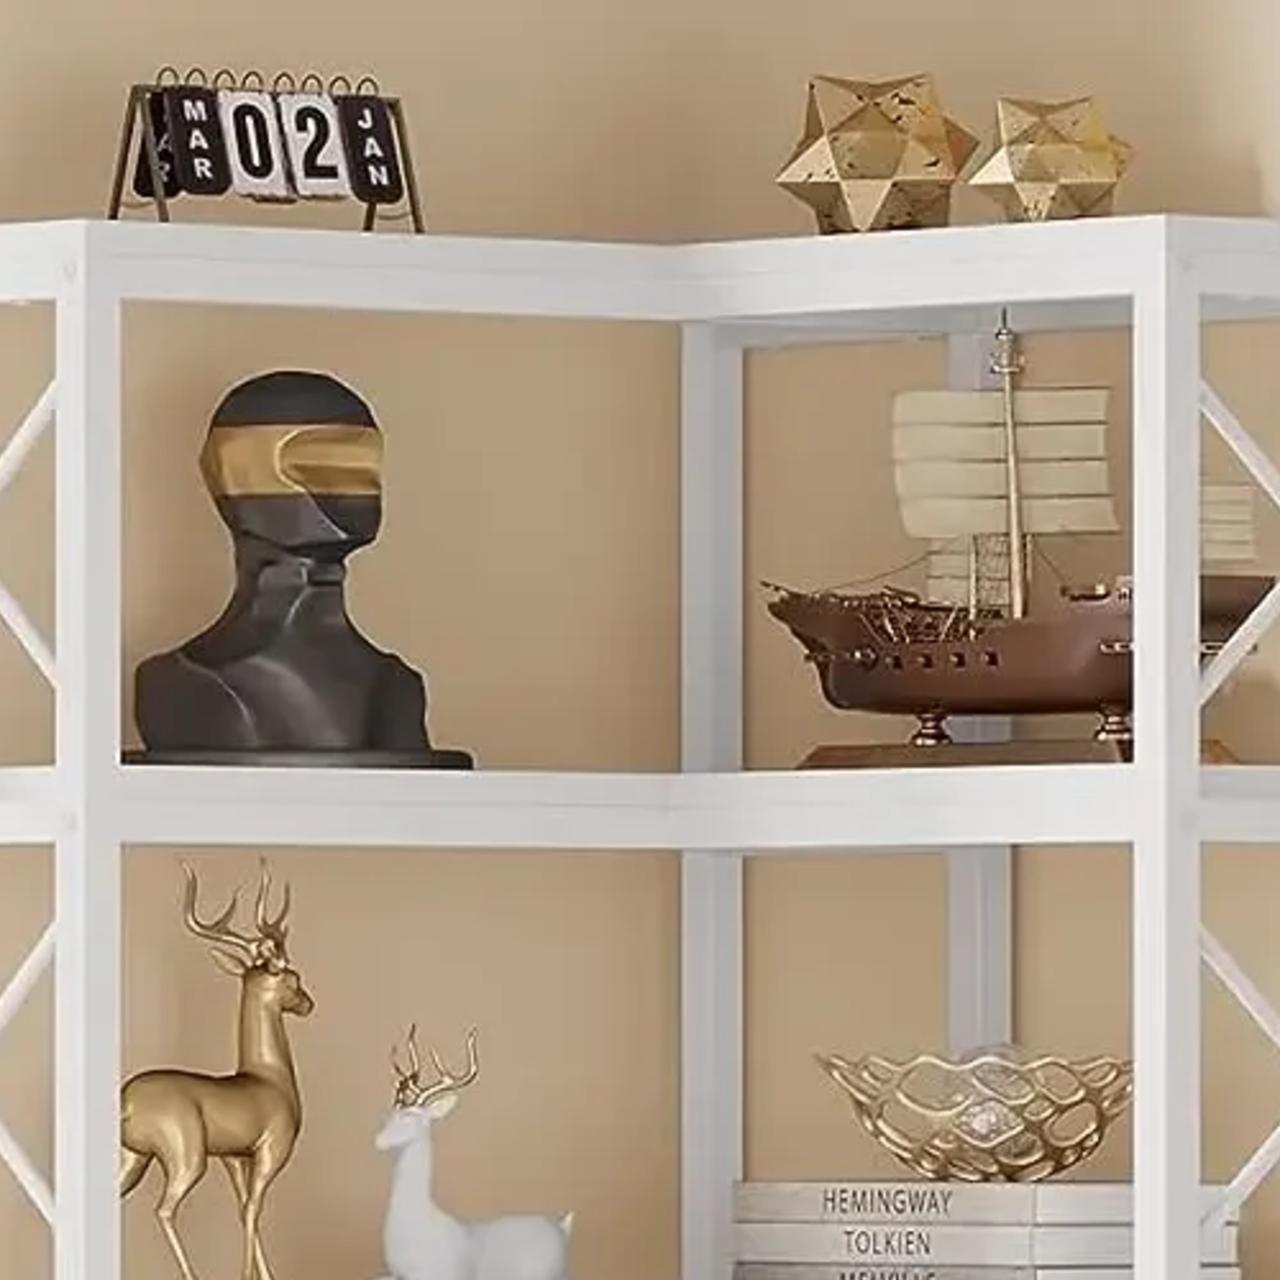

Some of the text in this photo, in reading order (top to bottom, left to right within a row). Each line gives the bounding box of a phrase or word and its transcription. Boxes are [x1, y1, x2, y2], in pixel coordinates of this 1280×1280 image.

[183, 99, 214, 179] MAR
[357, 107, 389, 186] JAN
[822, 1188, 954, 1215] HEMINGWAY
[843, 1230, 932, 1256] TOLKIEN
